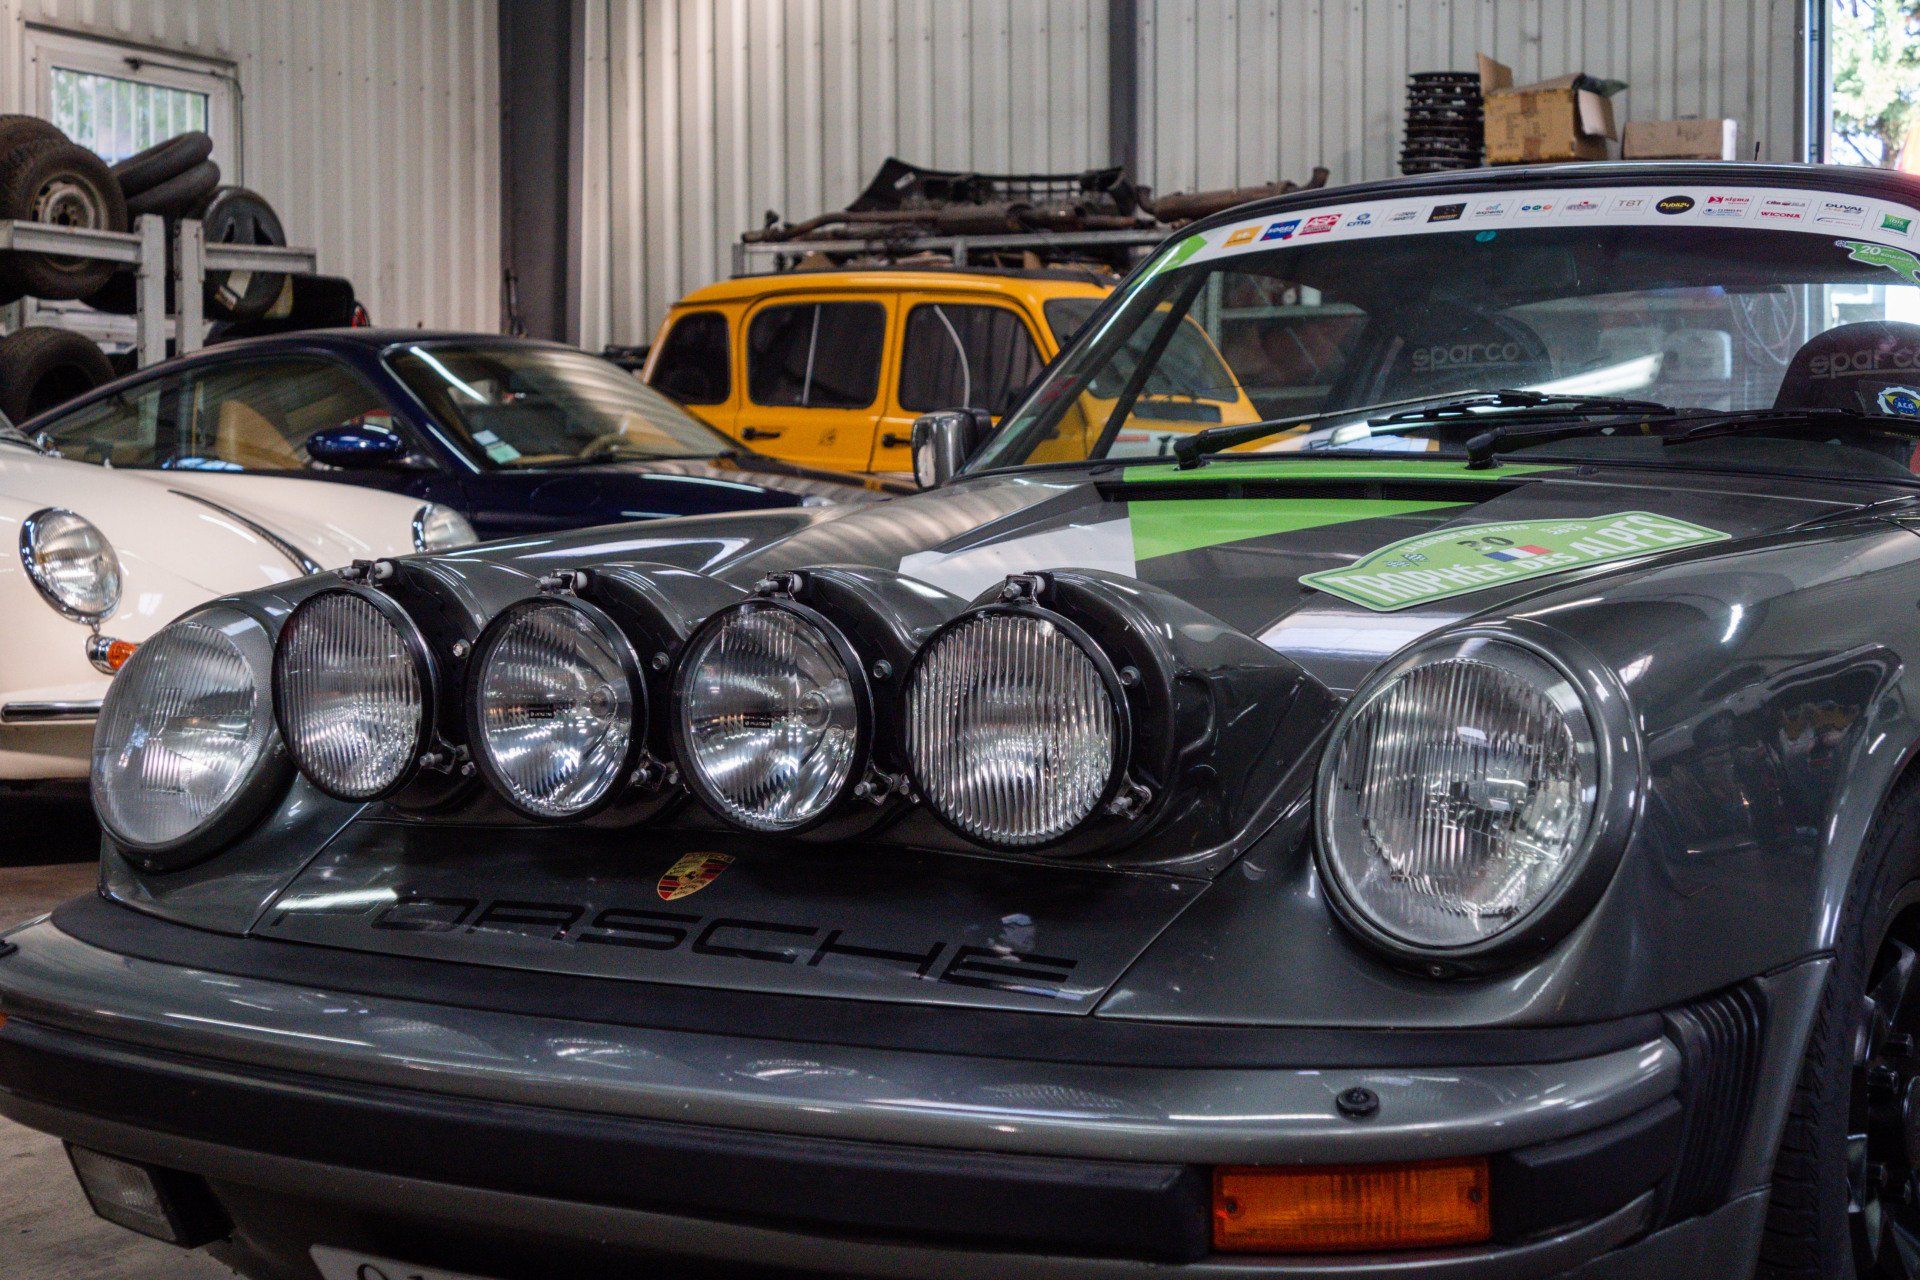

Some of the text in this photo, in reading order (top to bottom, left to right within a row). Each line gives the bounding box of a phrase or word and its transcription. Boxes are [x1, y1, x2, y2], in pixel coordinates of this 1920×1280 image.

[1618, 199, 1645, 207] TBT
[1825, 203, 1864, 212] DUVAL
[1761, 211, 1801, 219] WICONA
[1859, 245, 1881, 255] 20
[1411, 342, 1520, 371] sparco
[1320, 514, 1700, 602] TROPHÉE DES ALPES
[272, 890, 1080, 990] PORSCHE
